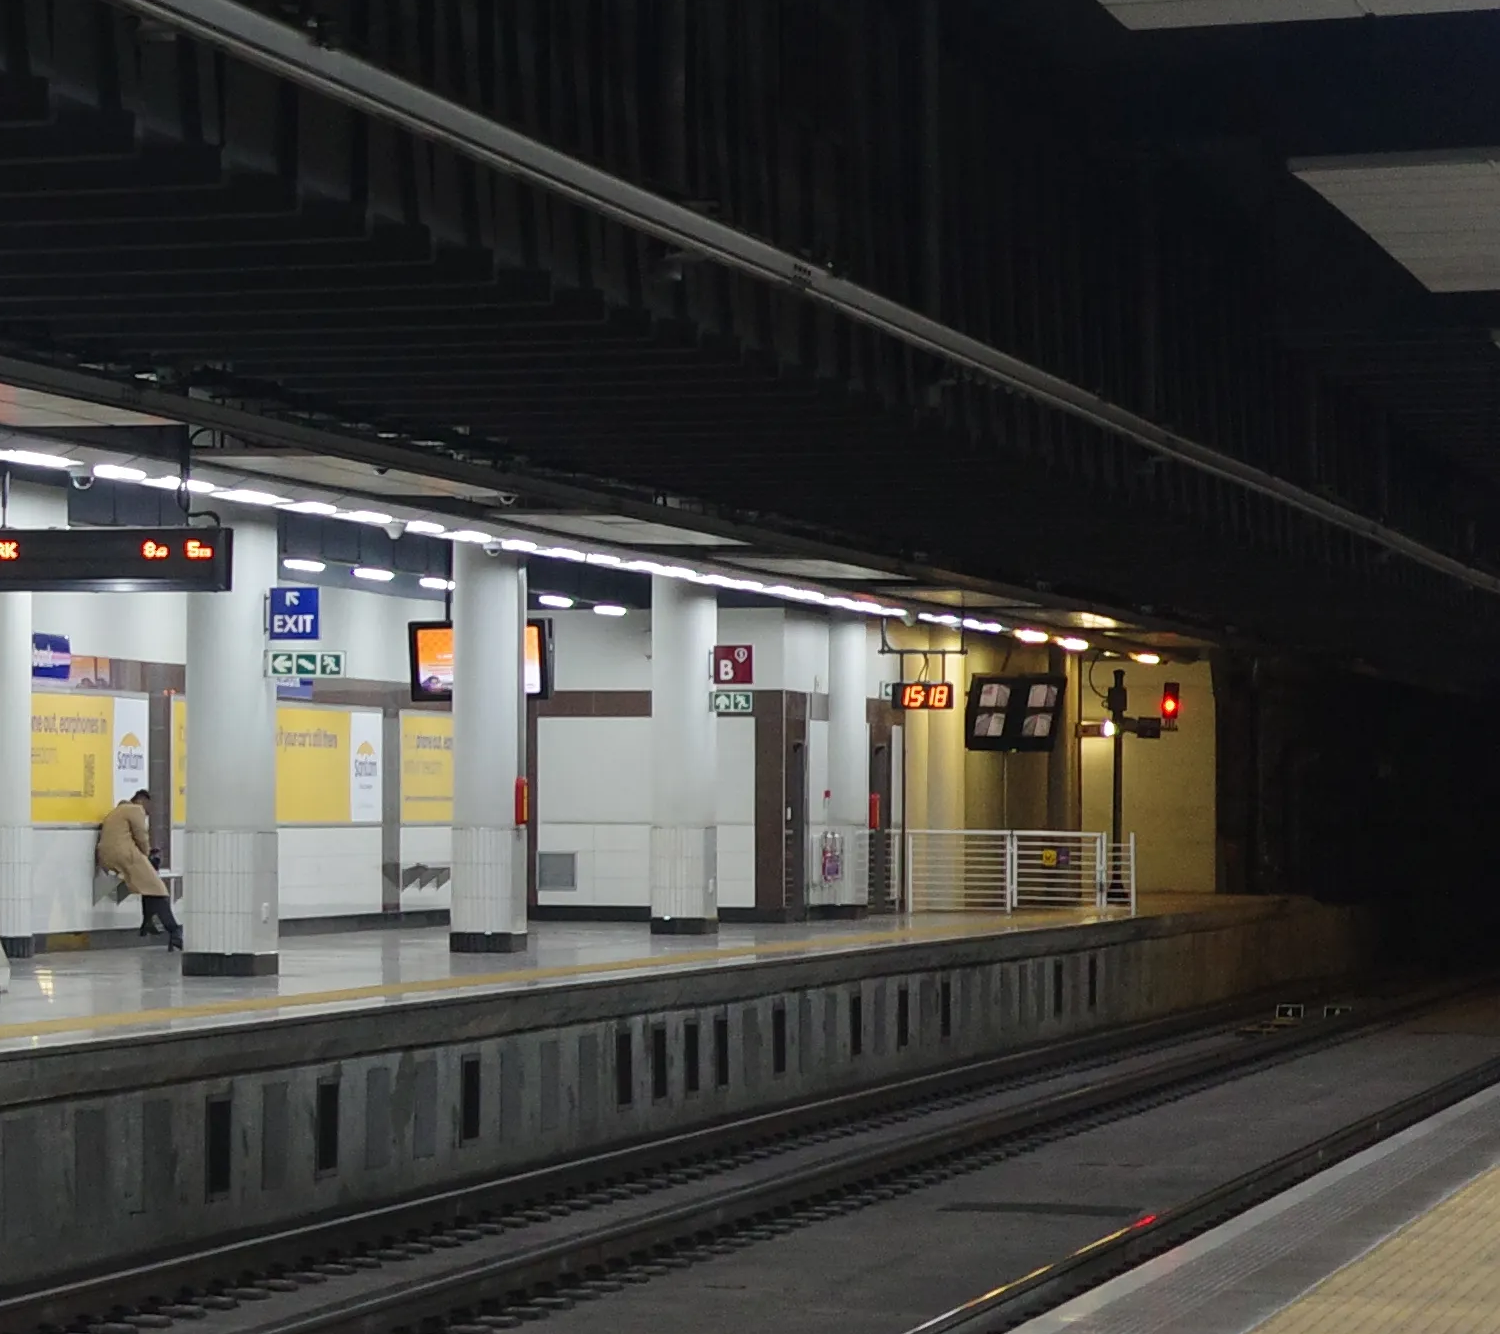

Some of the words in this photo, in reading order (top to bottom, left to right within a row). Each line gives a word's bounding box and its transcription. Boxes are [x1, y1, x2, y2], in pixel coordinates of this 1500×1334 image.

[273, 614, 314, 634] EXIT
[720, 659, 734, 680] B
[903, 685, 949, 708] 15:18
